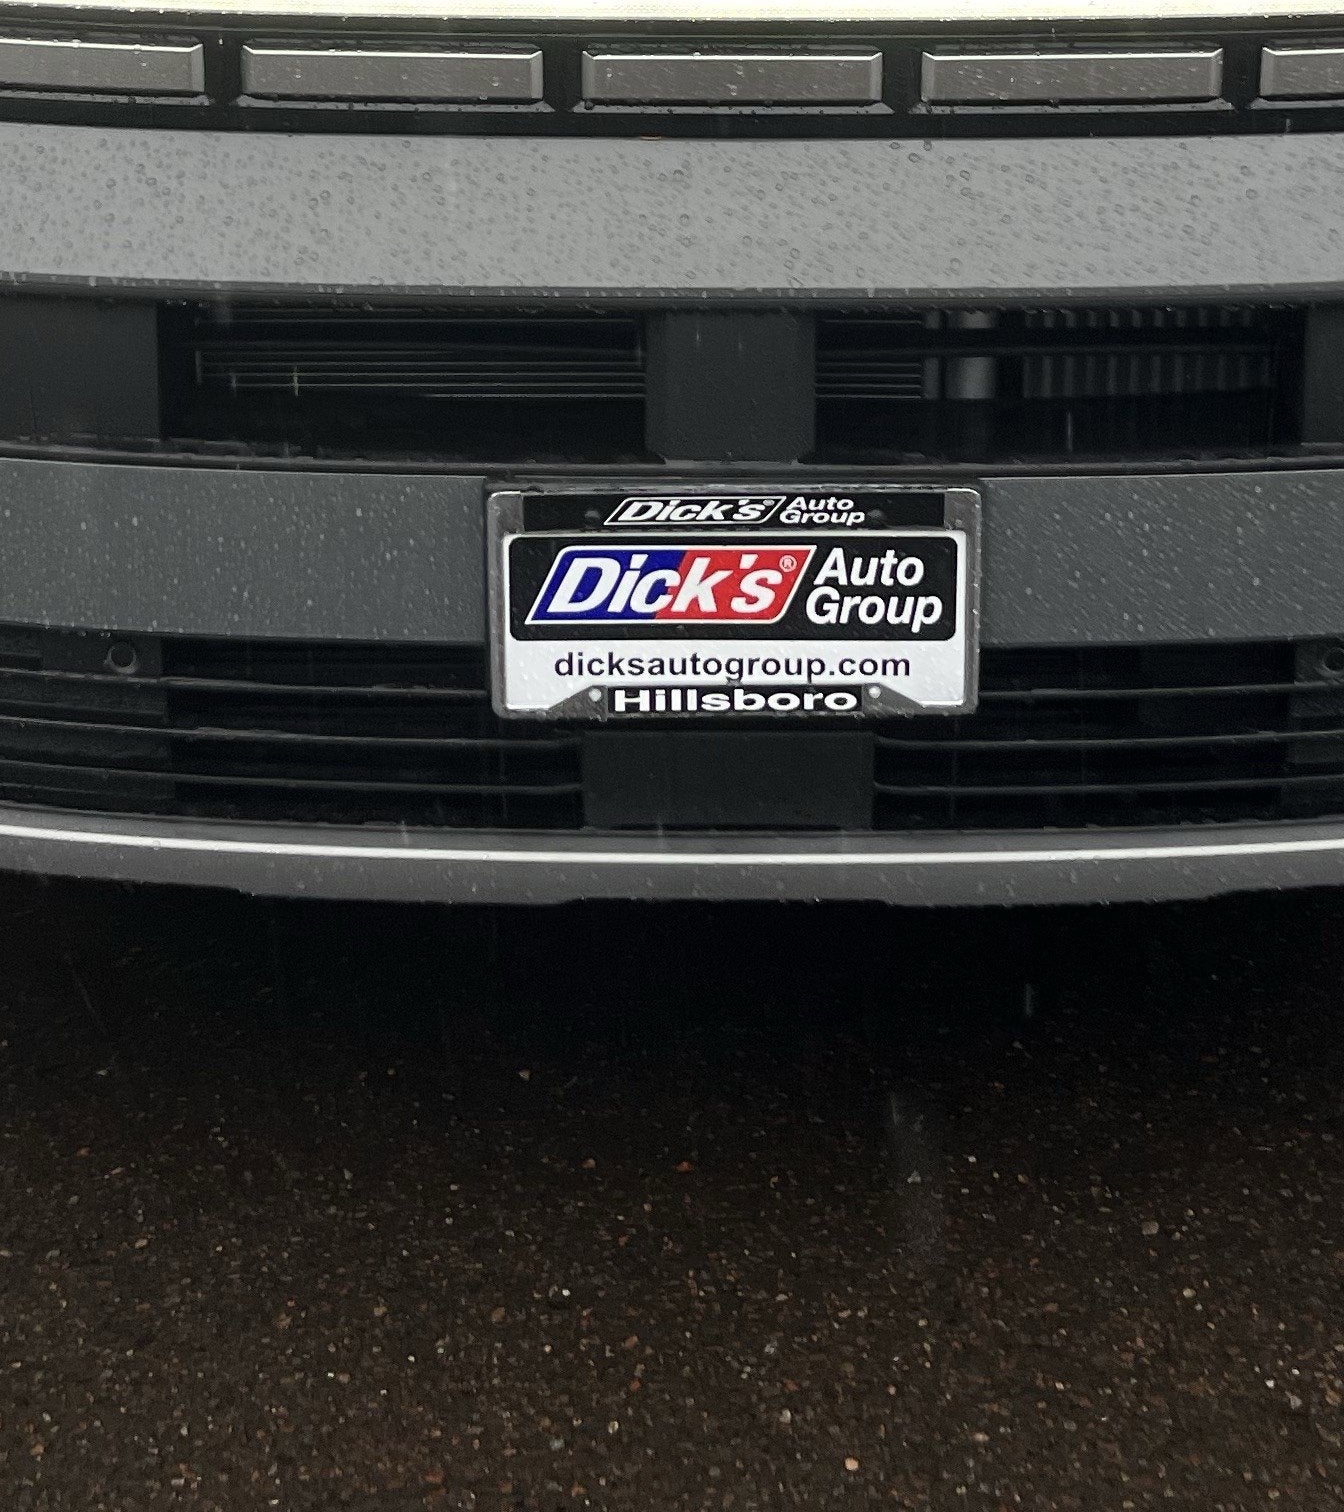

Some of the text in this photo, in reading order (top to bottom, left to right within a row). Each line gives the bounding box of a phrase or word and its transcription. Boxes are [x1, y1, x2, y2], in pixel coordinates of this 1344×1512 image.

[789, 495, 854, 511] Auto
[780, 509, 865, 526] Group
[814, 547, 925, 587] Auto
[805, 588, 943, 633] Group
[554, 651, 911, 682] dicksautogroup.com
[613, 688, 857, 713] Hillsboro
